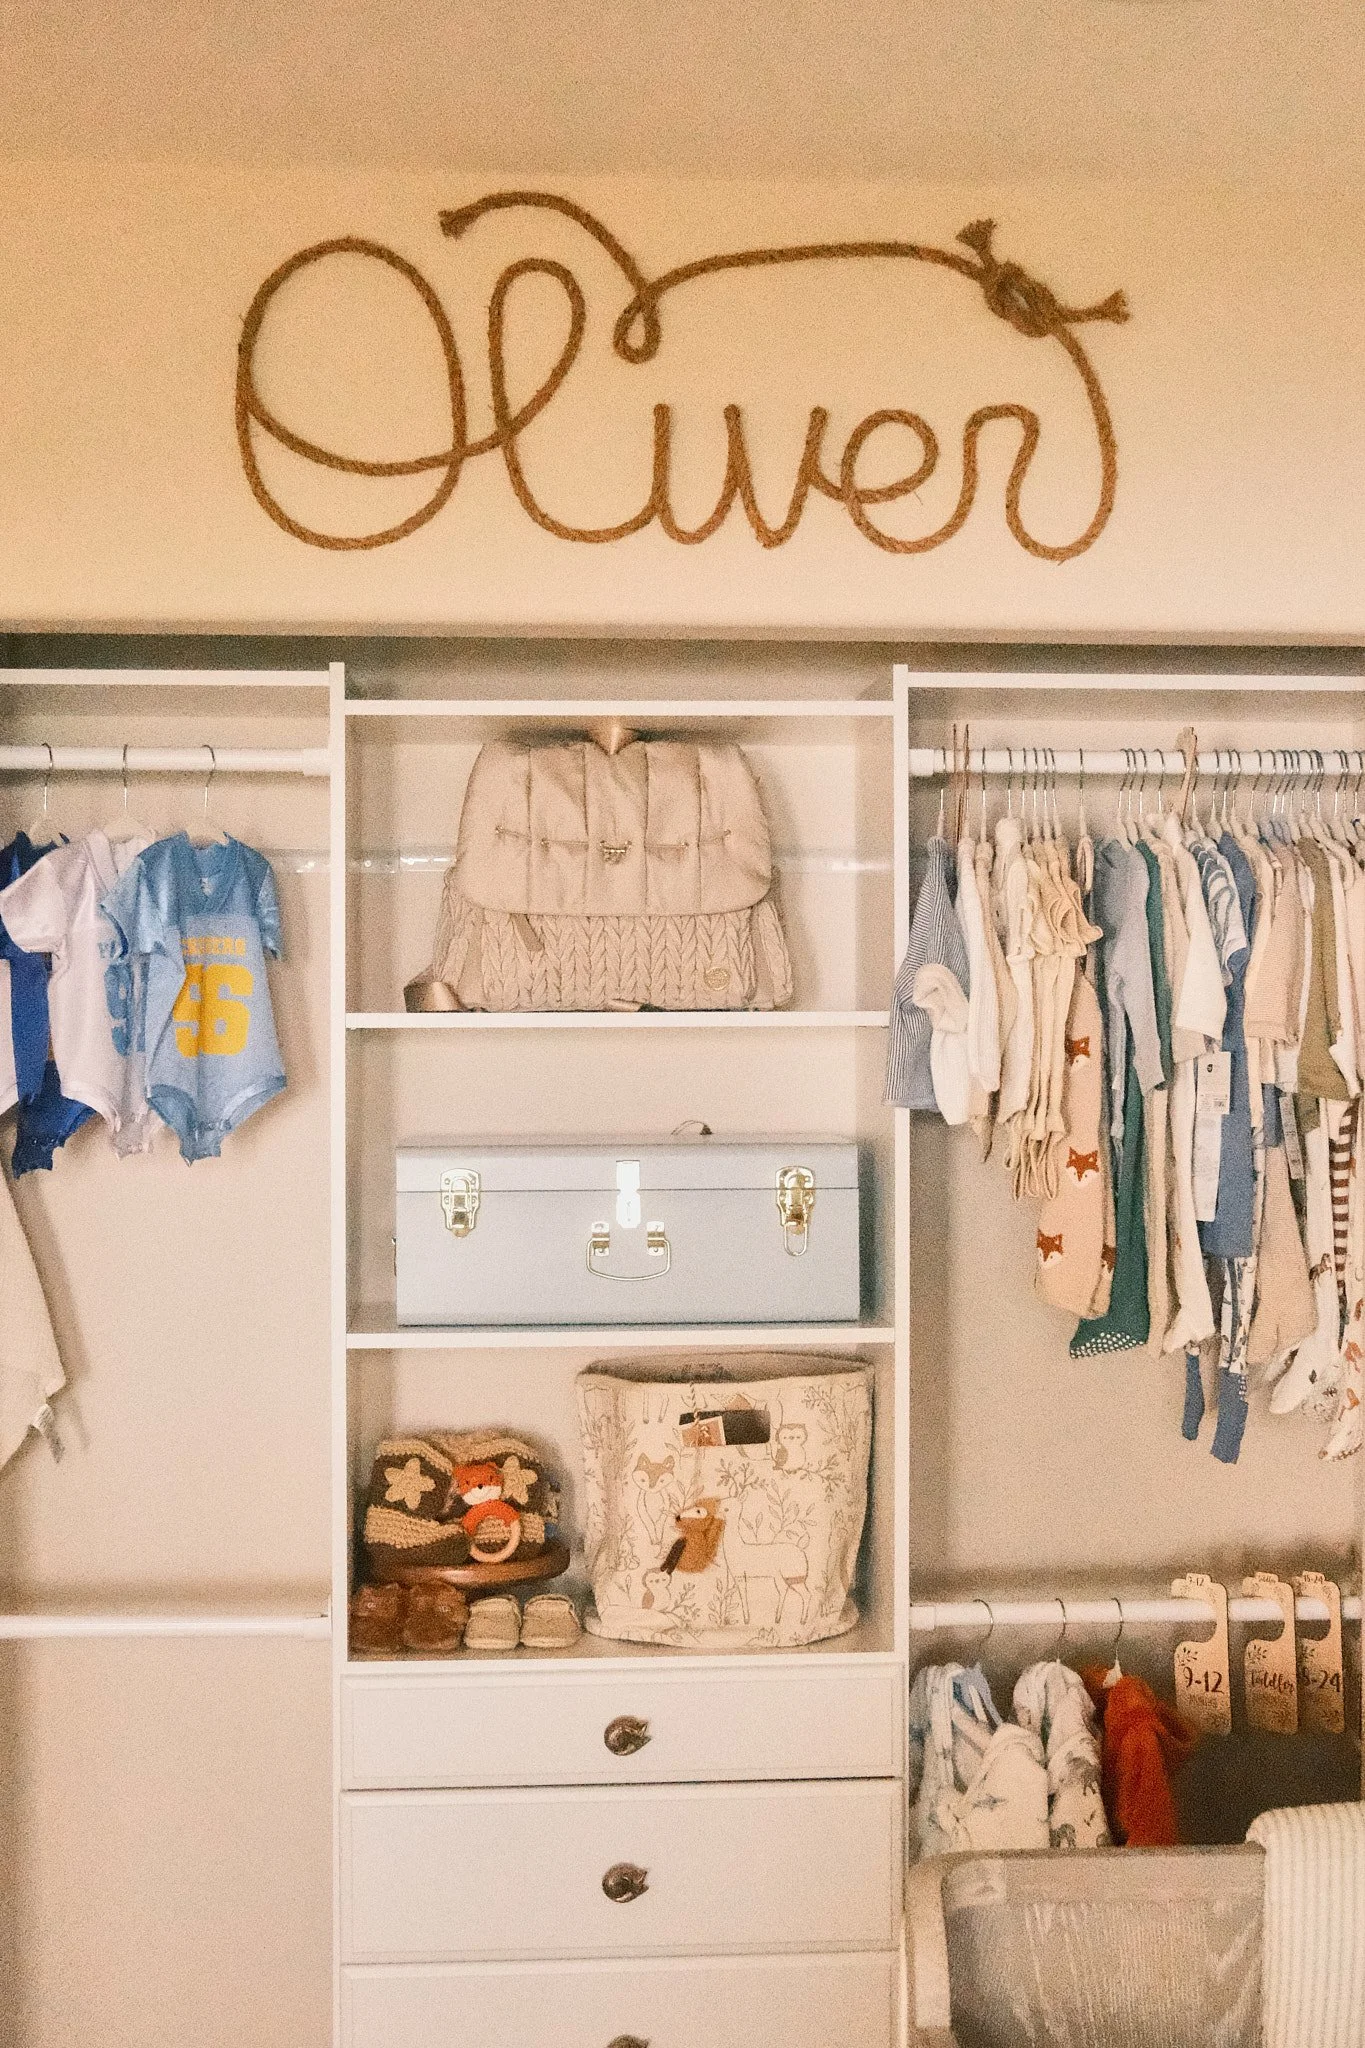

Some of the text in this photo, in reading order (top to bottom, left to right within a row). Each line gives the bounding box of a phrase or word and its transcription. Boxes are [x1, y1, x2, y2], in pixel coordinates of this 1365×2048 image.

[235, 236, 1118, 562] Oliver
[172, 963, 254, 1058] 96
[1182, 1666, 1225, 1695] 9-12
